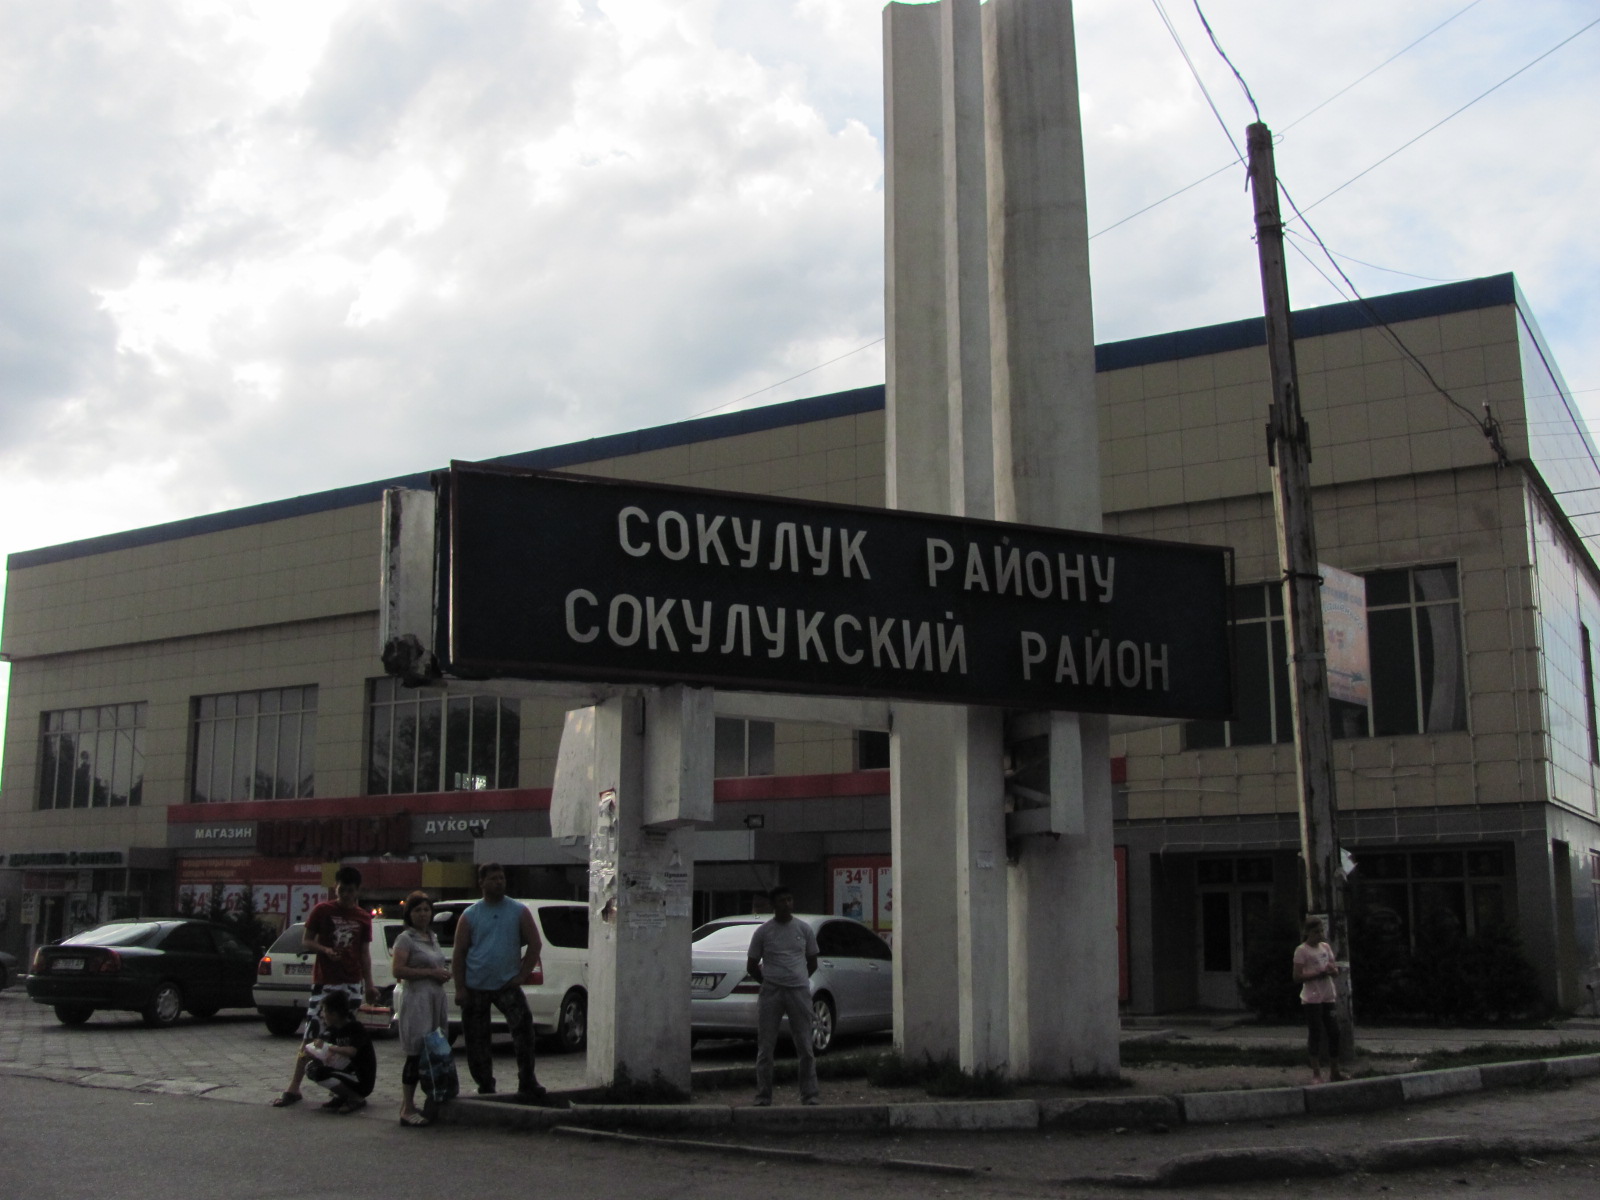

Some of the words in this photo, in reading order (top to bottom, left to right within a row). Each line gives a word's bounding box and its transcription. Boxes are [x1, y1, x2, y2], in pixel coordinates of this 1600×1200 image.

[617, 505, 871, 580] СОКУЛУК
[926, 535, 1117, 604] РАЙОНУ
[564, 588, 968, 676] СОКУЛУКСКИЙ
[1020, 627, 1171, 694] РАЙОН
[195, 827, 252, 839] МАГАЗИН
[845, 869, 862, 884] 34
[263, 892, 280, 912] 34
